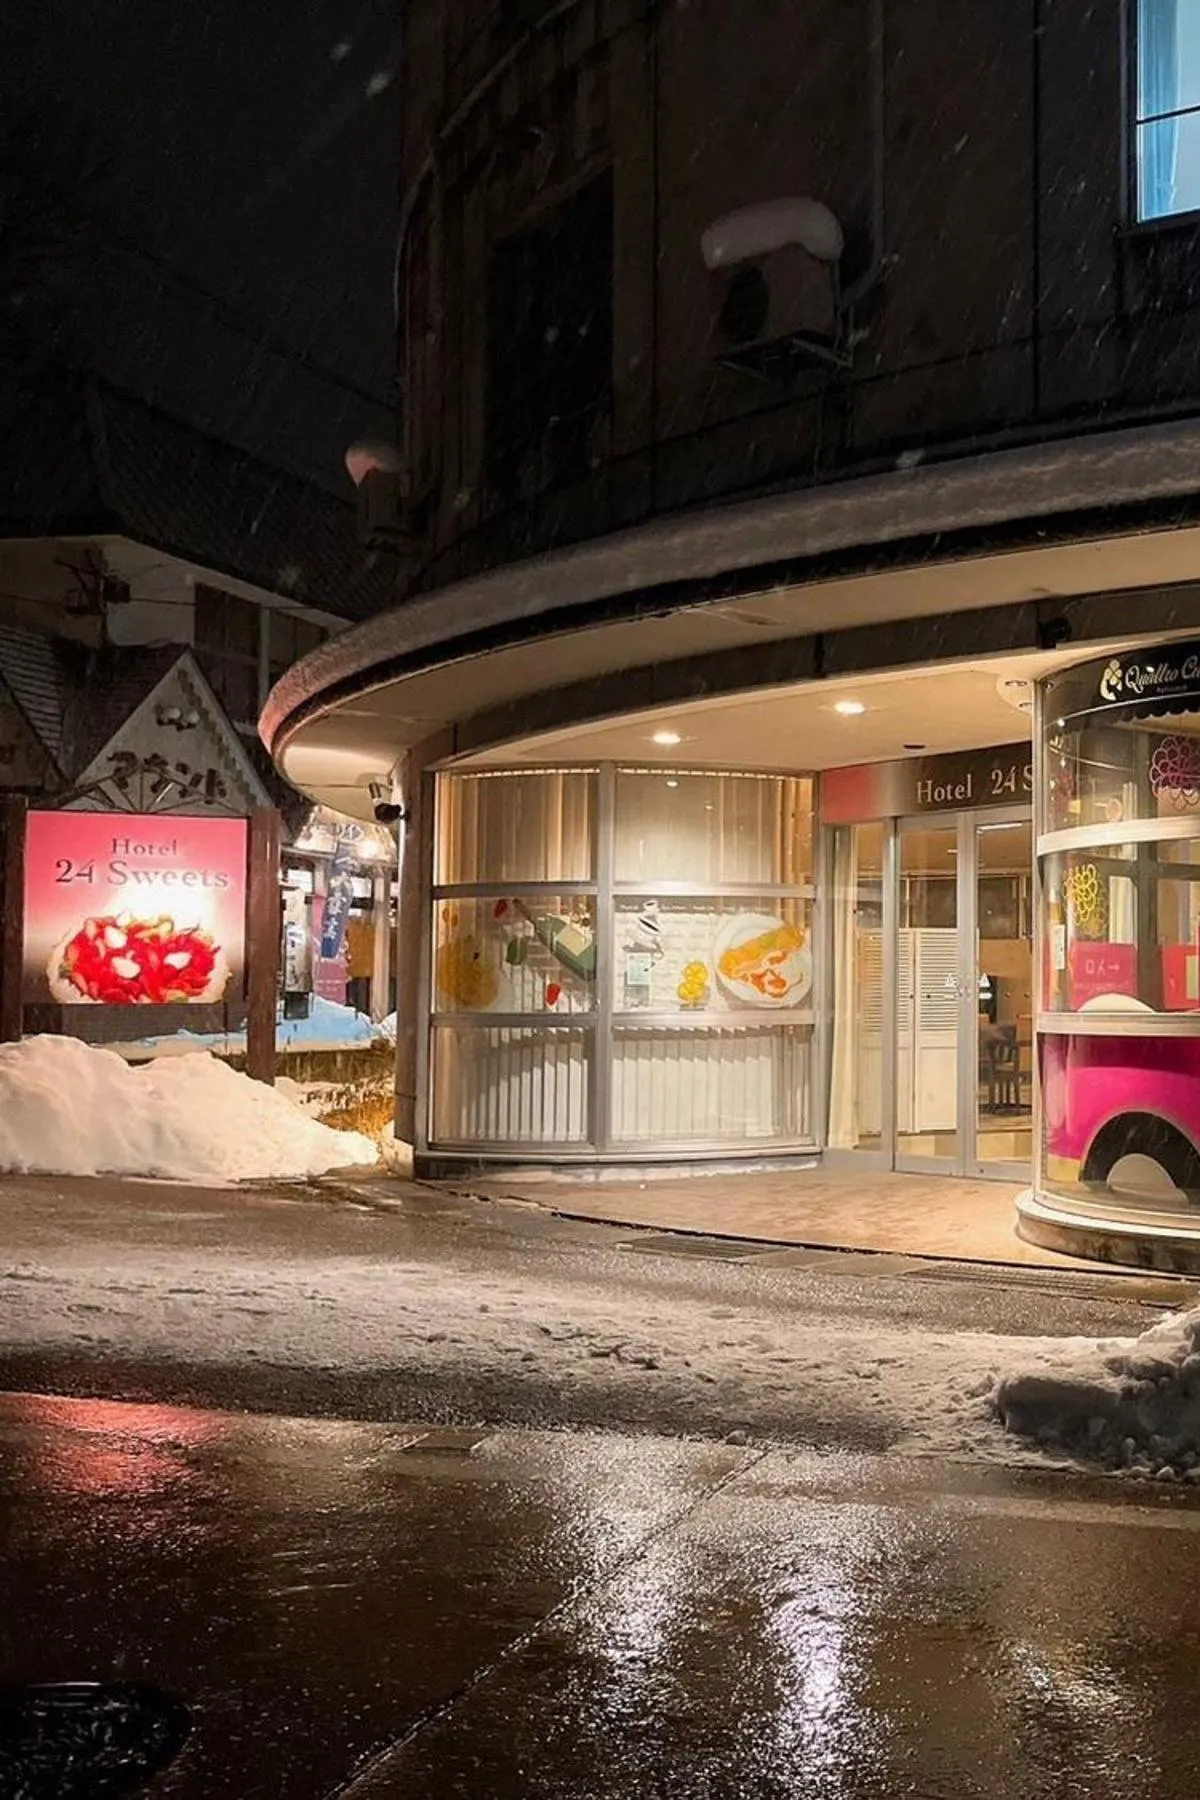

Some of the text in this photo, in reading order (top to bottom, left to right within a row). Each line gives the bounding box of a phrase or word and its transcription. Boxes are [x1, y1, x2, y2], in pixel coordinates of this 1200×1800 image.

[916, 774, 973, 803] Hotel
[991, 765, 1016, 795] 24
[111, 838, 178, 858] Hotel
[55, 858, 230, 889] 24 Sweets
